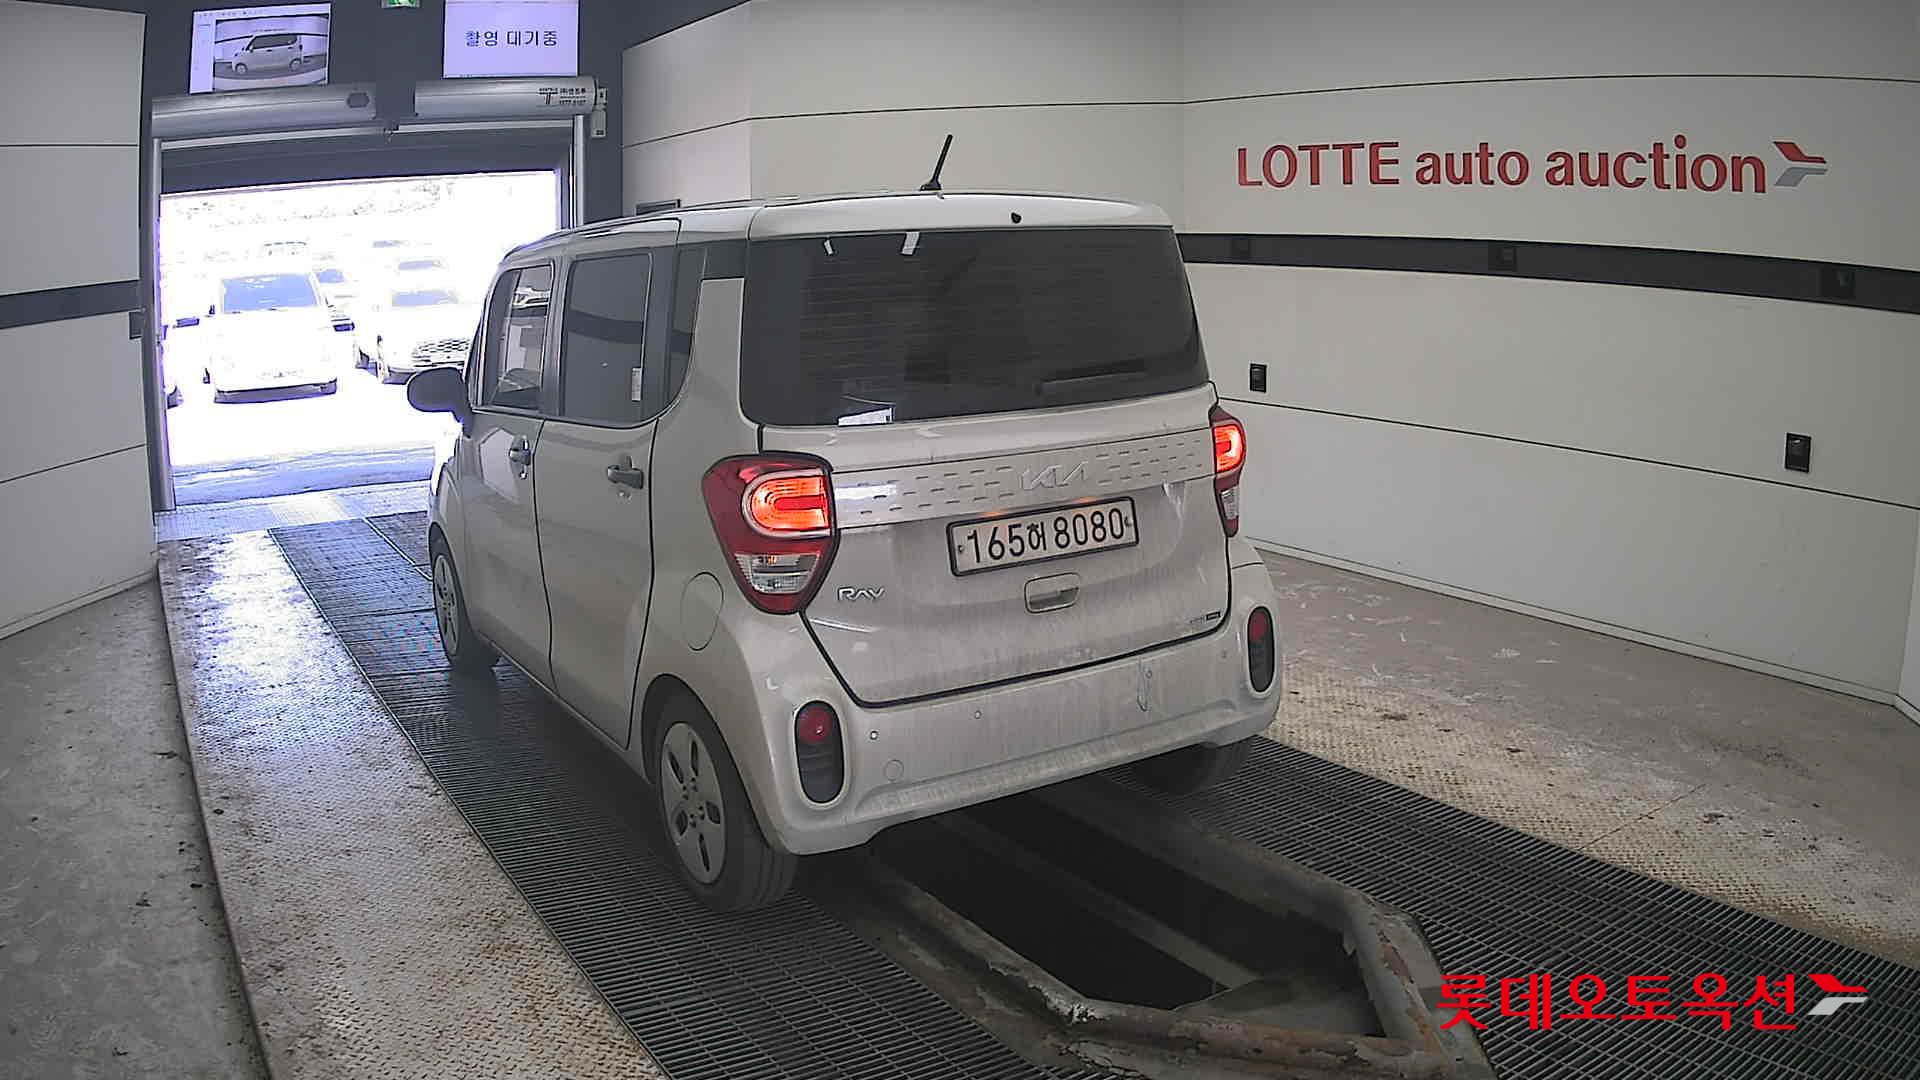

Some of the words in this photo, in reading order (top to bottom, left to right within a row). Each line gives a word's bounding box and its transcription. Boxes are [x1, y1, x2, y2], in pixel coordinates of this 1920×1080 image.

[465, 30, 498, 47] 촬영
[1237, 141, 1400, 188] LOTTE
[1415, 141, 1530, 187] auto
[1545, 134, 1767, 194] auction
[967, 521, 1048, 564] 165허
[1053, 507, 1125, 549] 8080
